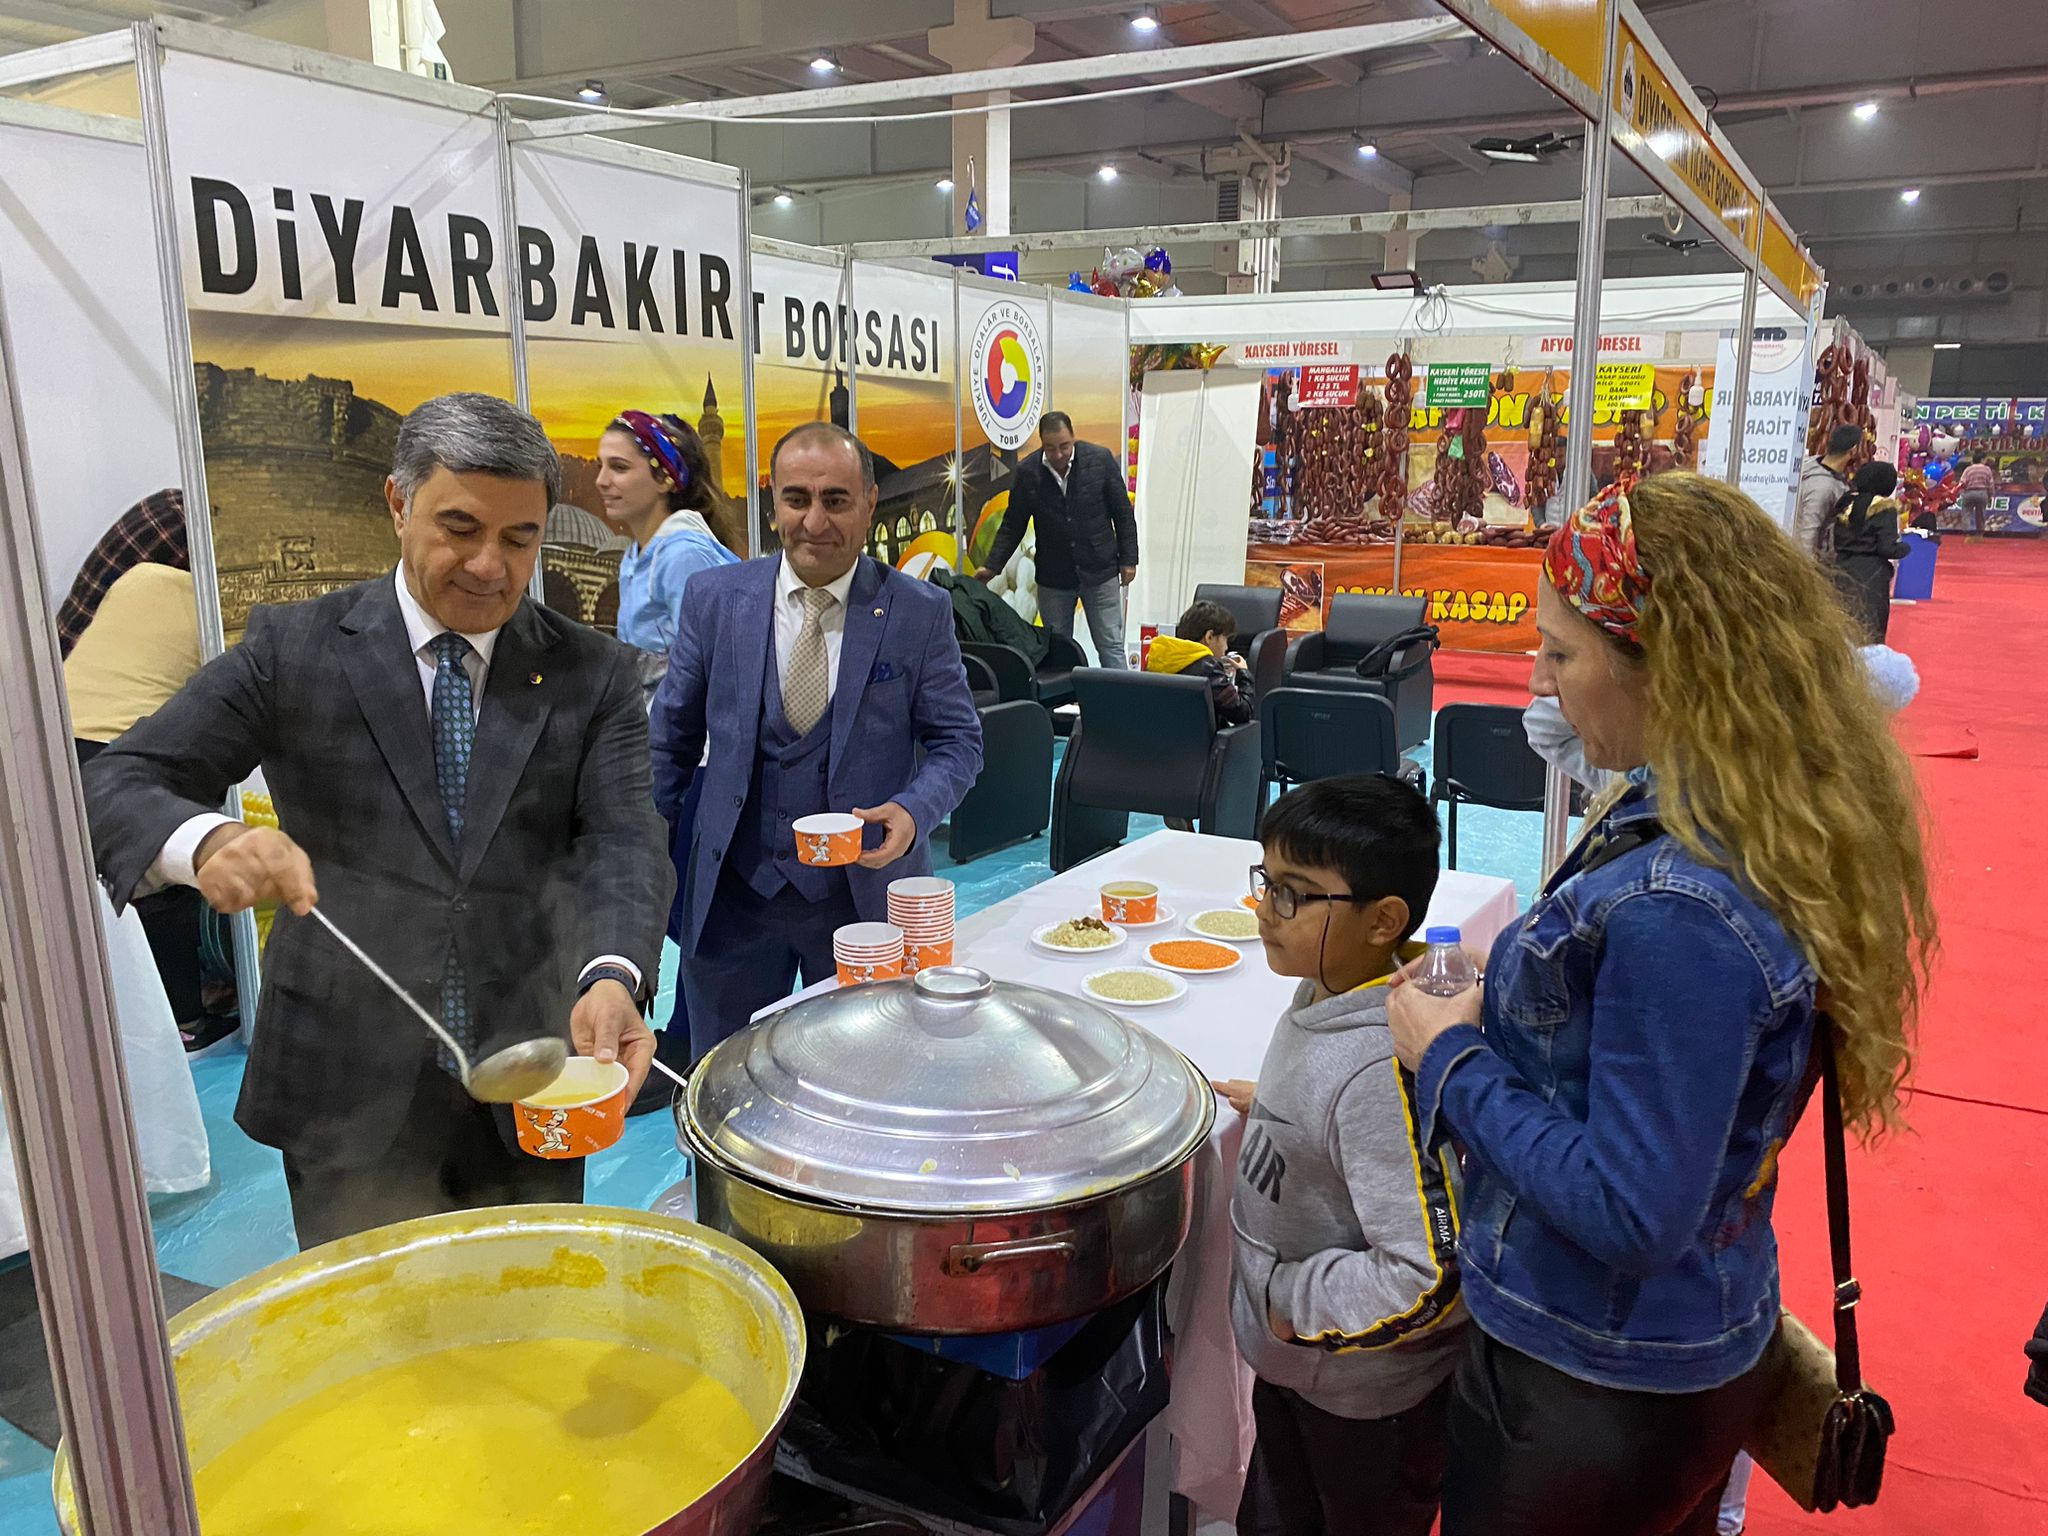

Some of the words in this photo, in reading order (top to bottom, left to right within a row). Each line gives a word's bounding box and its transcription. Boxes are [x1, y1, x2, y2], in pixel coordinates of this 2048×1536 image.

[784, 296, 938, 373] BORSASI
[974, 312, 997, 359] ODALAR
[1000, 308, 1010, 318] VE
[1014, 311, 1042, 373] BORSALAR
[1245, 341, 1290, 358] KAYSERİ
[1293, 341, 1339, 356] YÖRESEL
[1541, 337, 1574, 352] AFYO
[1597, 336, 1641, 351] RESEL
[1460, 367, 1489, 376] YÖRESEL
[1599, 365, 1642, 373] KAYSERİ
[1463, 390, 1486, 398] 250TL
[1000, 434, 1019, 445] TOBB
[1431, 590, 1529, 624] KASAP
